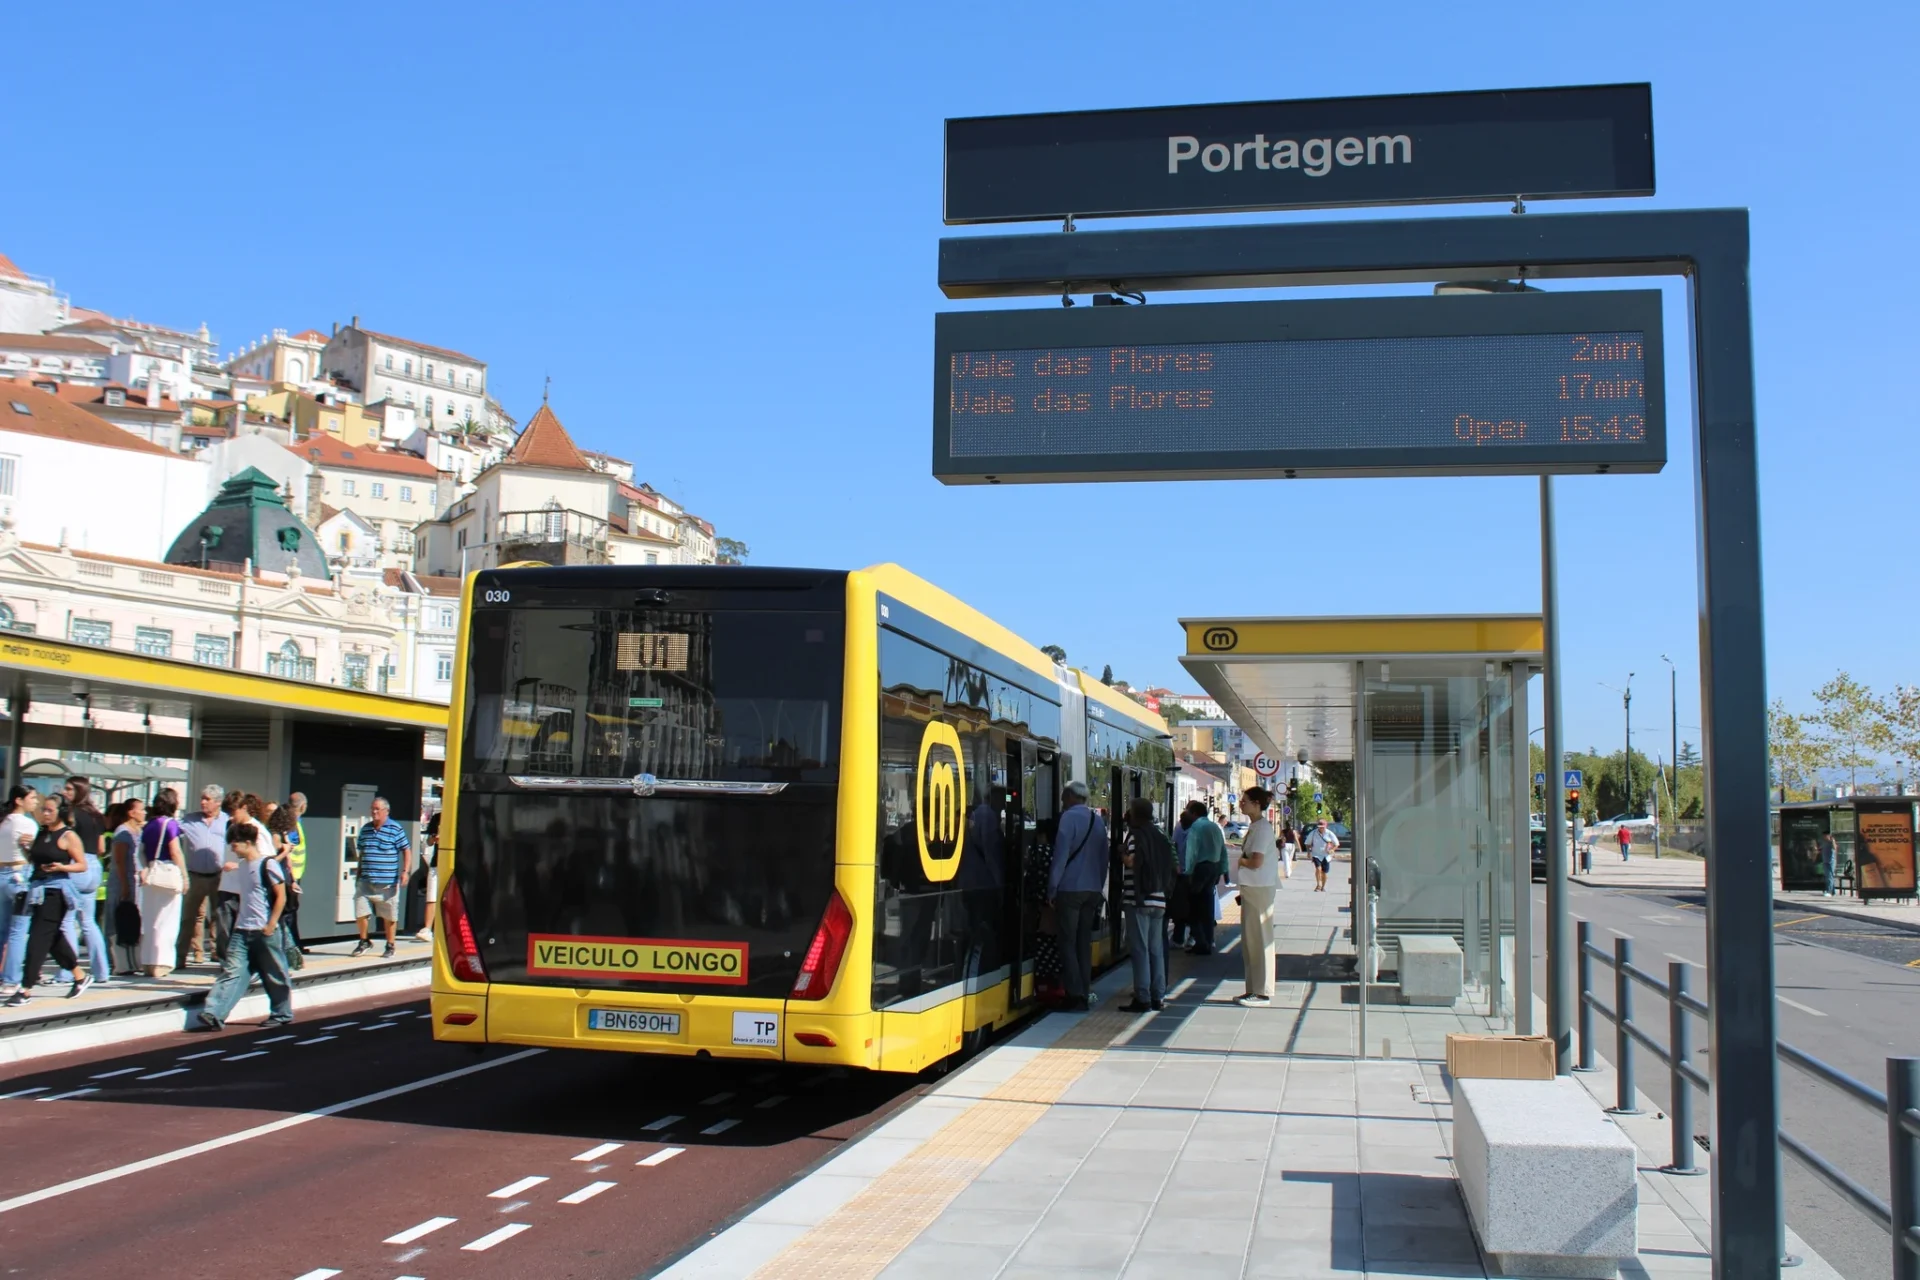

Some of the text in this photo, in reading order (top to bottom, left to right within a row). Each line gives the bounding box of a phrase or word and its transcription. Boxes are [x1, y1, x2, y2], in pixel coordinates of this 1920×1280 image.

[1168, 134, 1412, 177] Portagem
[951, 335, 1644, 378] Vale das Flores 2min
[951, 373, 1644, 414] Vale das Flores 17min
[1455, 413, 1646, 446] Oper 15:43
[485, 590, 510, 602] 030
[3, 644, 72, 665] metro mondego
[638, 635, 669, 668] U1
[1257, 758, 1276, 769] 50
[538, 945, 738, 972] VEICULO LONGO
[754, 1021, 776, 1036] TP
